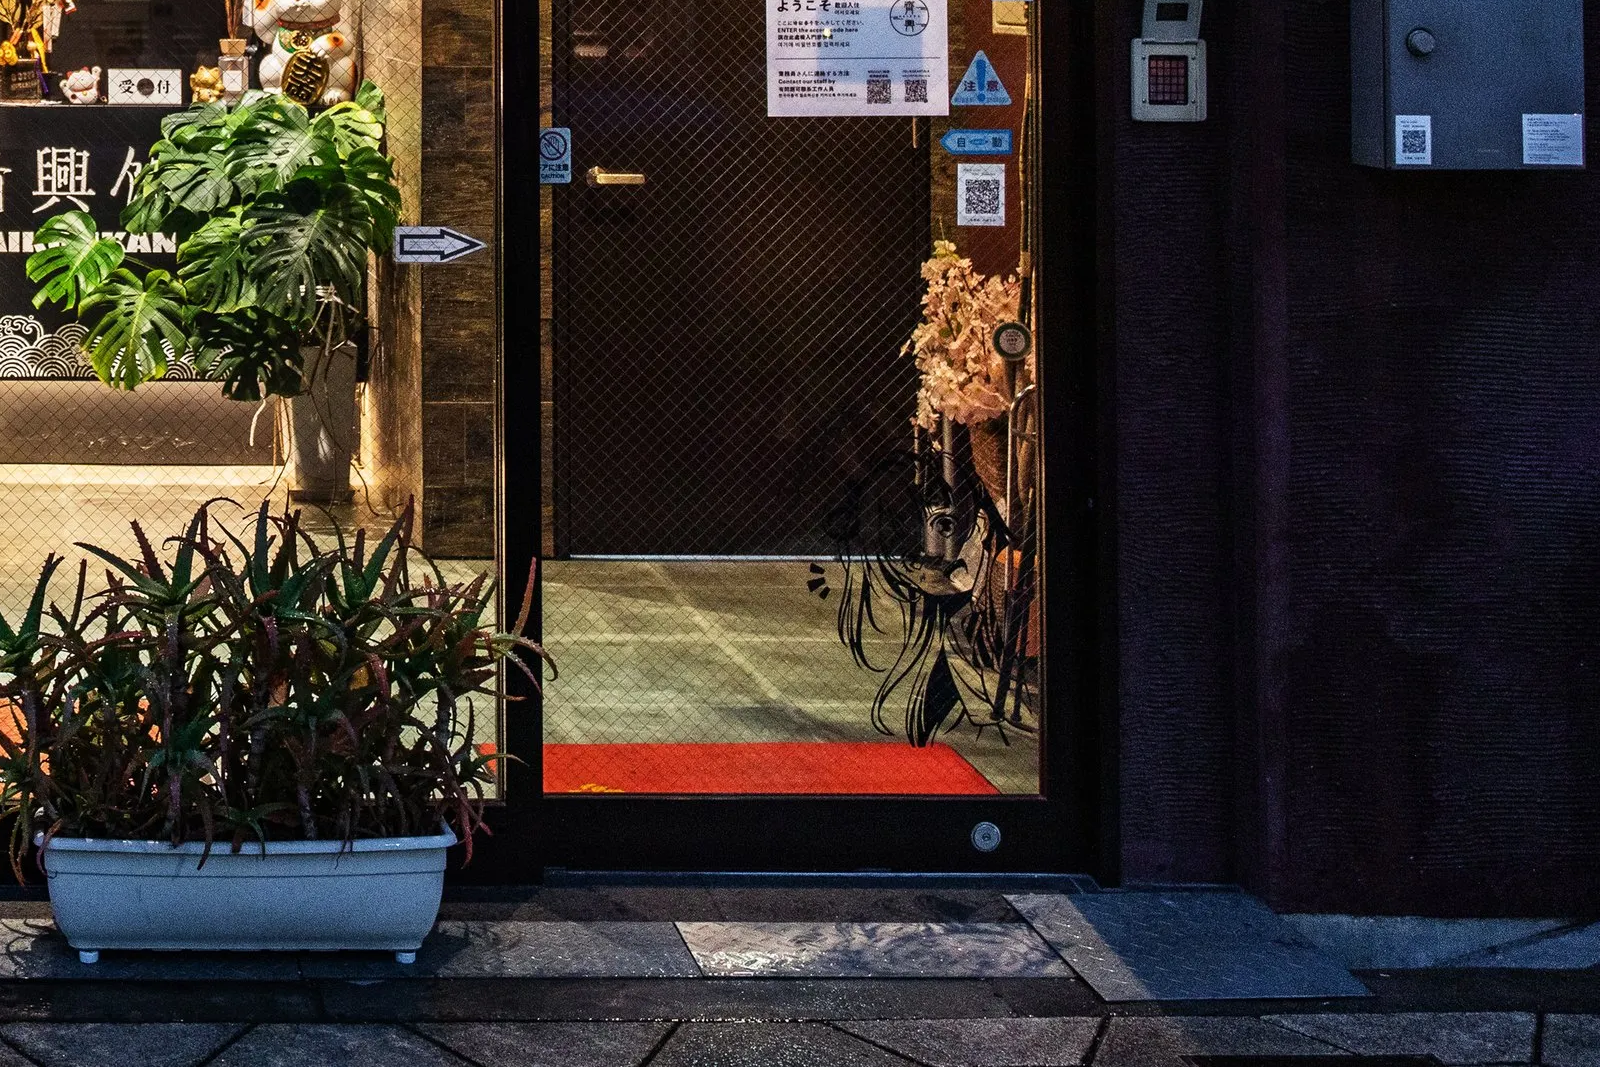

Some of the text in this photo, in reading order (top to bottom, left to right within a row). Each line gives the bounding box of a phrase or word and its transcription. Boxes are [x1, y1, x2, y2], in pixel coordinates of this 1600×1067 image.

[777, 0, 831, 13] ようこそ
[118, 79, 171, 95] 受付
[963, 80, 1000, 92] 注意
[540, 164, 569, 172] アに注意
